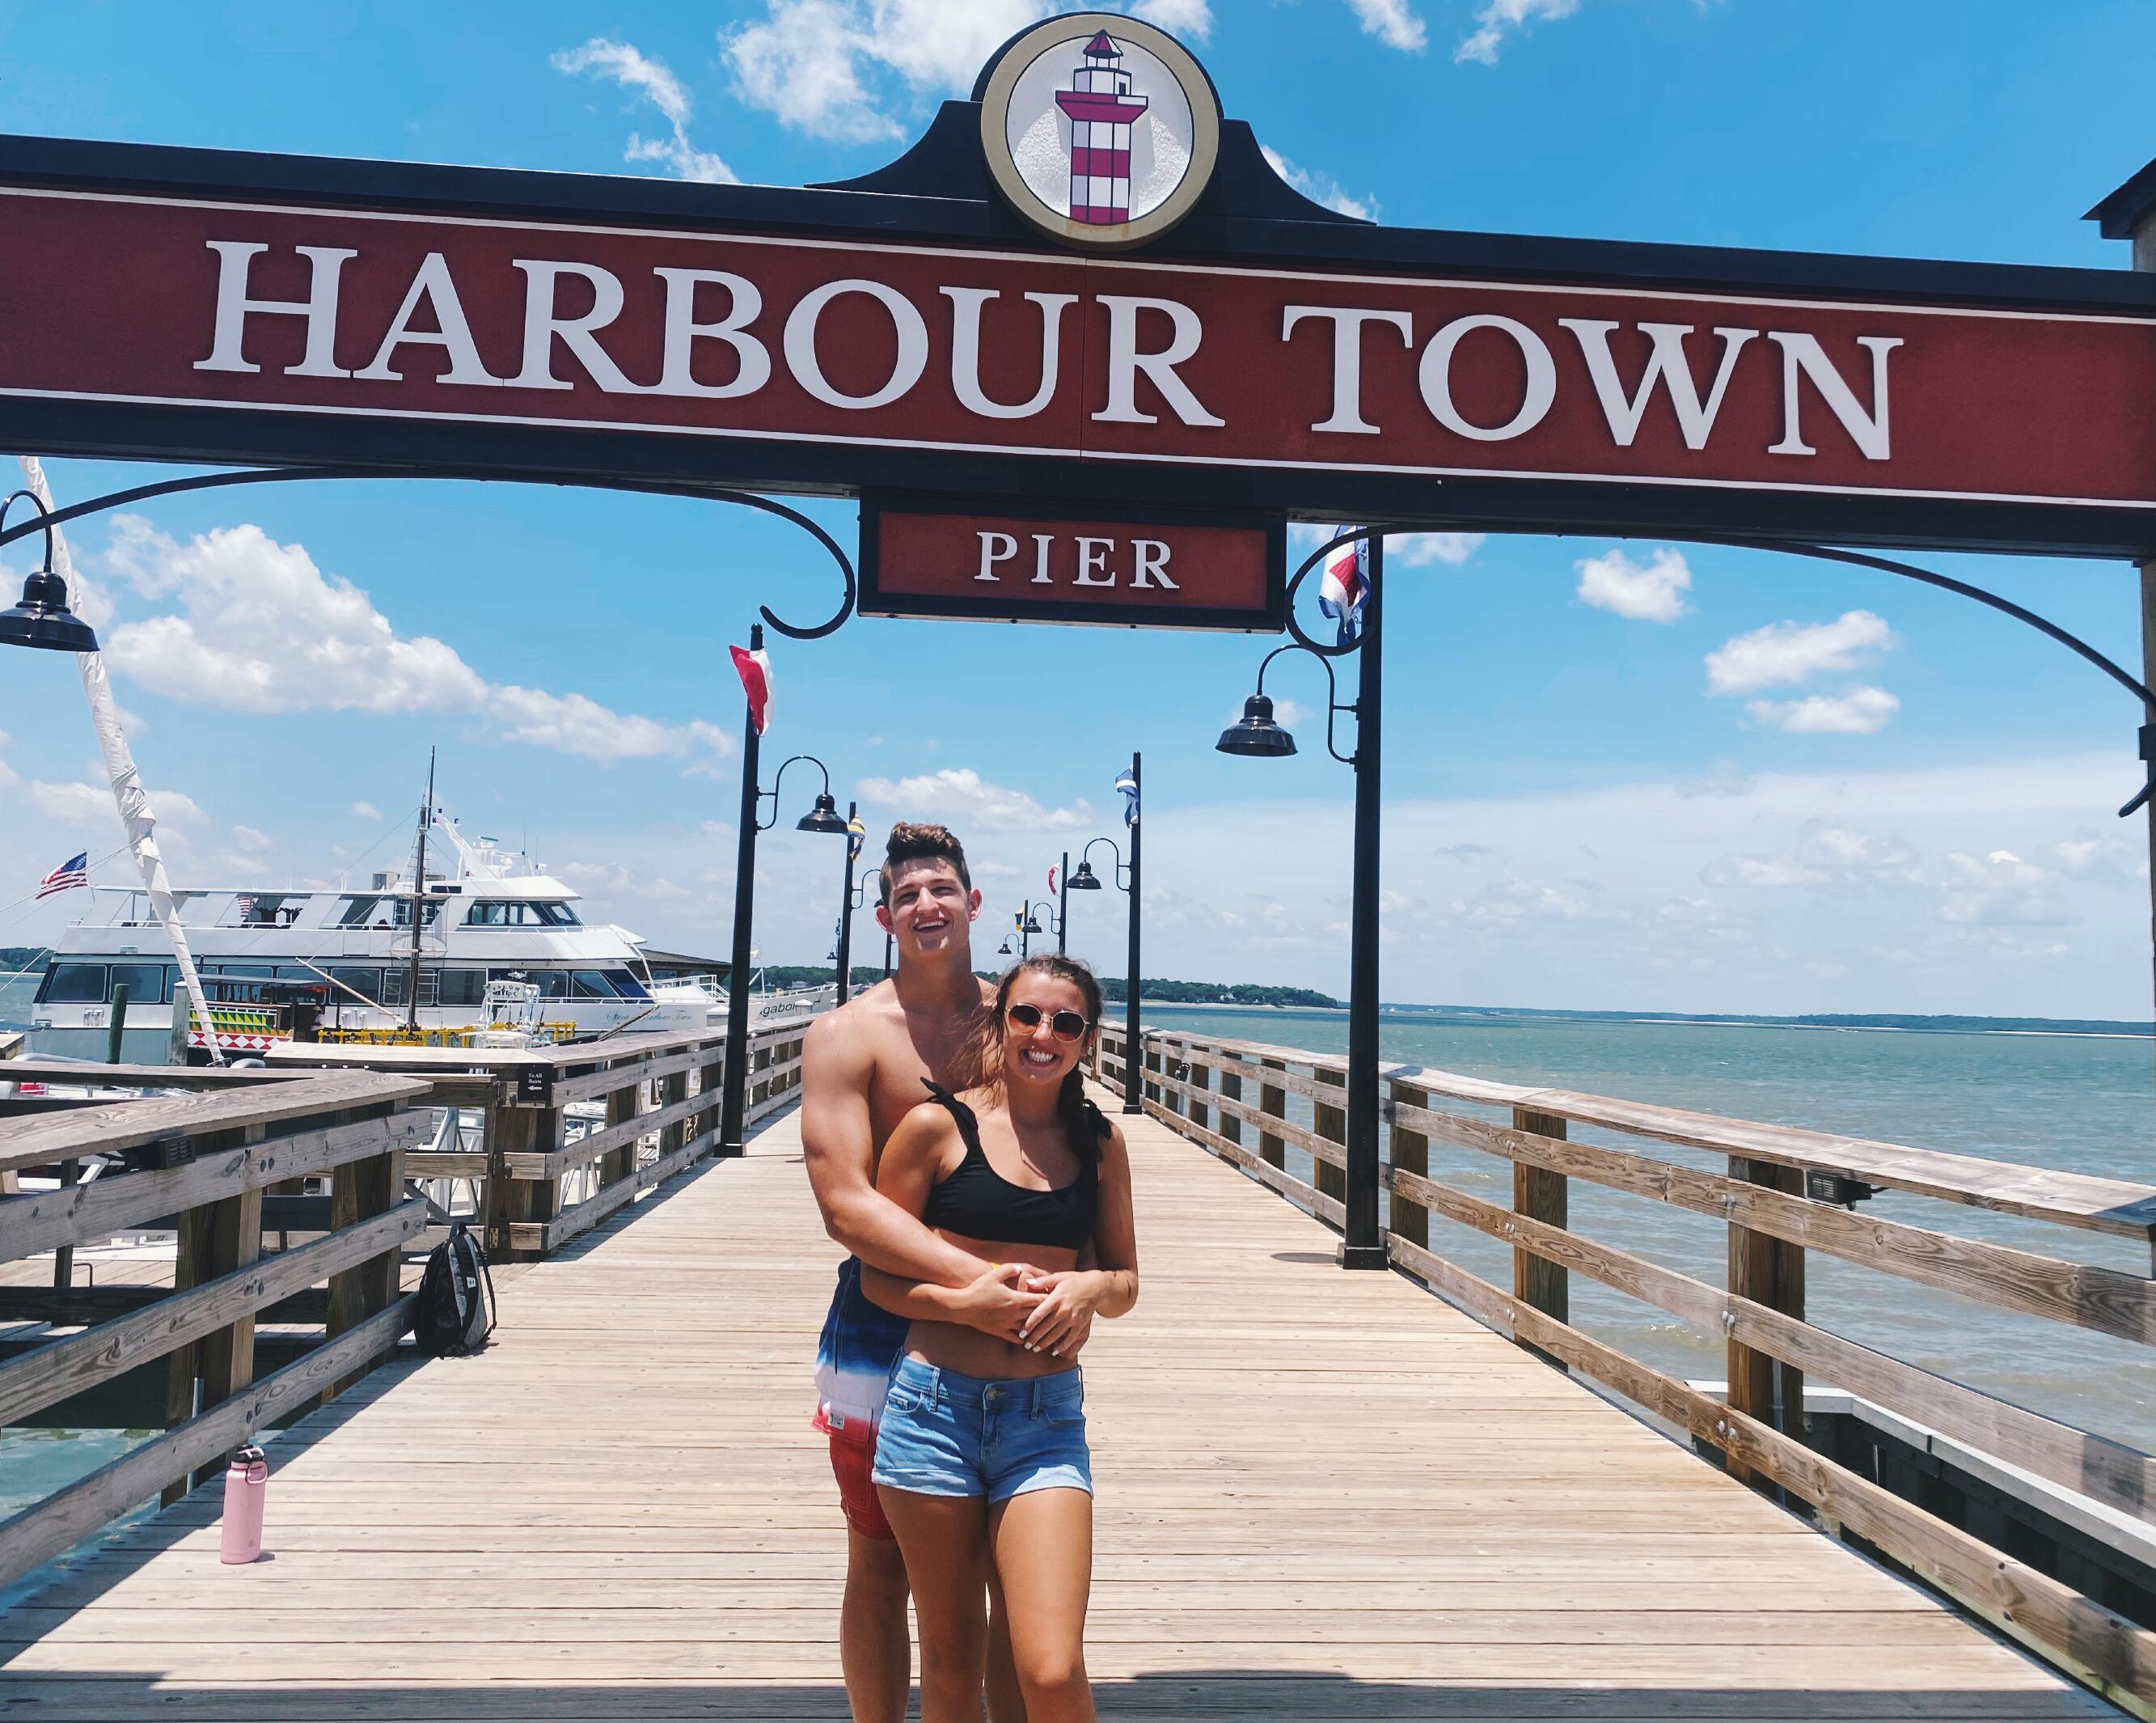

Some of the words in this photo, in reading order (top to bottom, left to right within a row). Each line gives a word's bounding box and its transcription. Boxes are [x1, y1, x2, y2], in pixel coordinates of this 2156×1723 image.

[192, 239, 1226, 429] HARBOUR
[1281, 305, 1905, 461] TOWN
[974, 531, 1181, 590] PIER
